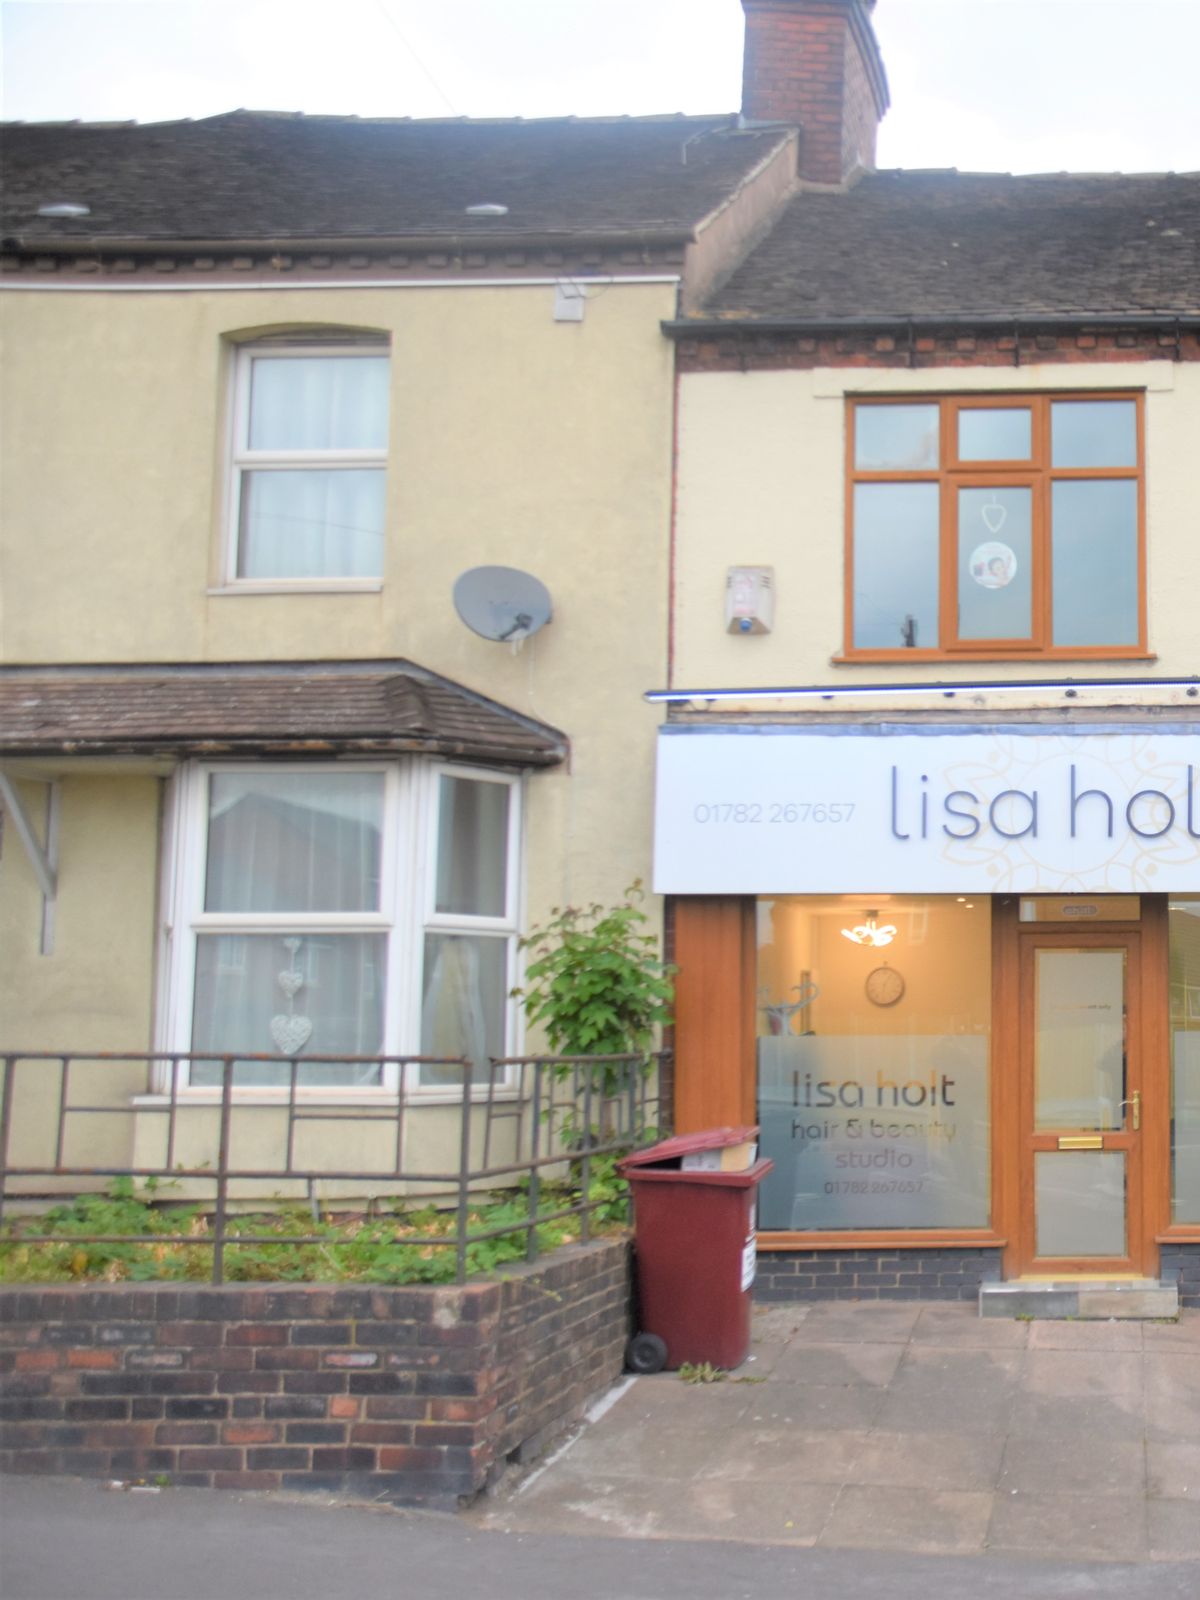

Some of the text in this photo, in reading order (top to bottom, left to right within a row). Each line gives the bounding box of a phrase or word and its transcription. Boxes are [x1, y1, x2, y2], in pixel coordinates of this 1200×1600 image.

[693, 803, 857, 824] 01782 267657
[891, 764, 1039, 841] lisa
[791, 1069, 956, 1107] lisa holt
[791, 1118, 957, 1142] hair & beauty
[835, 1147, 913, 1168] studio
[823, 1181, 869, 1194] 01782
